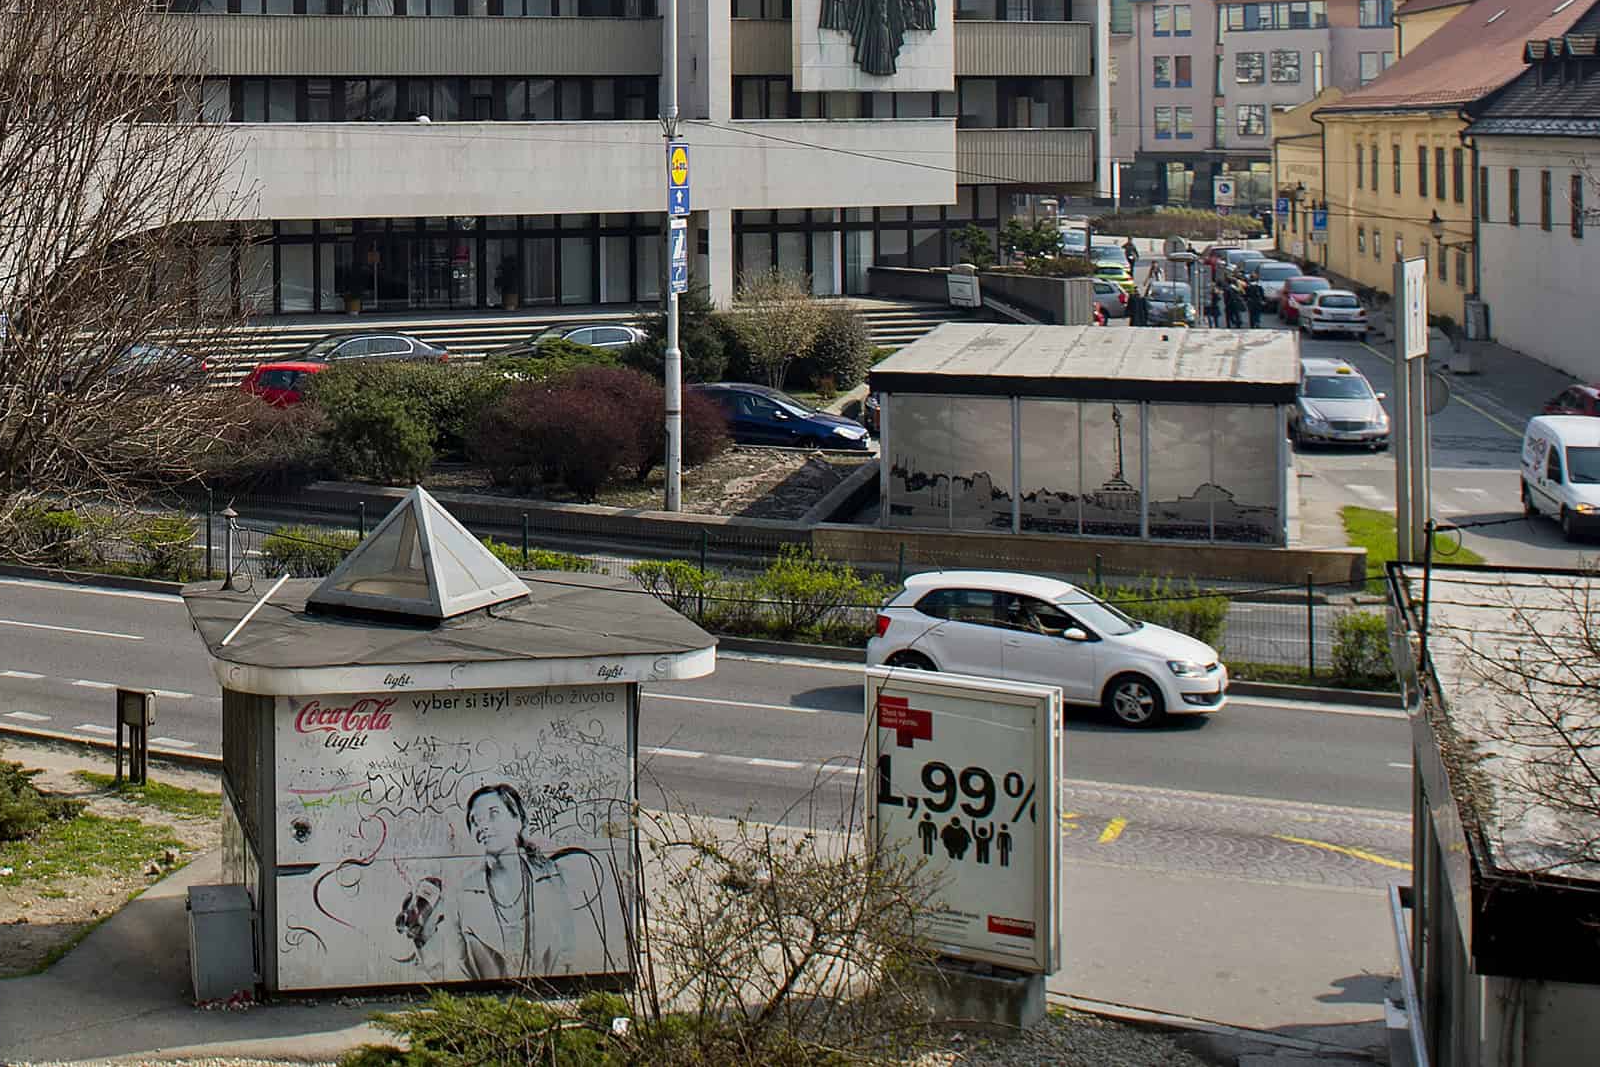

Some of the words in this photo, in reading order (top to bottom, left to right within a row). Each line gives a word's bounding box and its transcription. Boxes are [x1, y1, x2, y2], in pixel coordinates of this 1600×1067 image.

[412, 693, 460, 714] vyber
[465, 693, 477, 709] si
[482, 687, 509, 712] štýl
[514, 687, 564, 710] svojho
[568, 689, 616, 705] života
[295, 697, 398, 733] Coca-Cola
[324, 732, 368, 754] light
